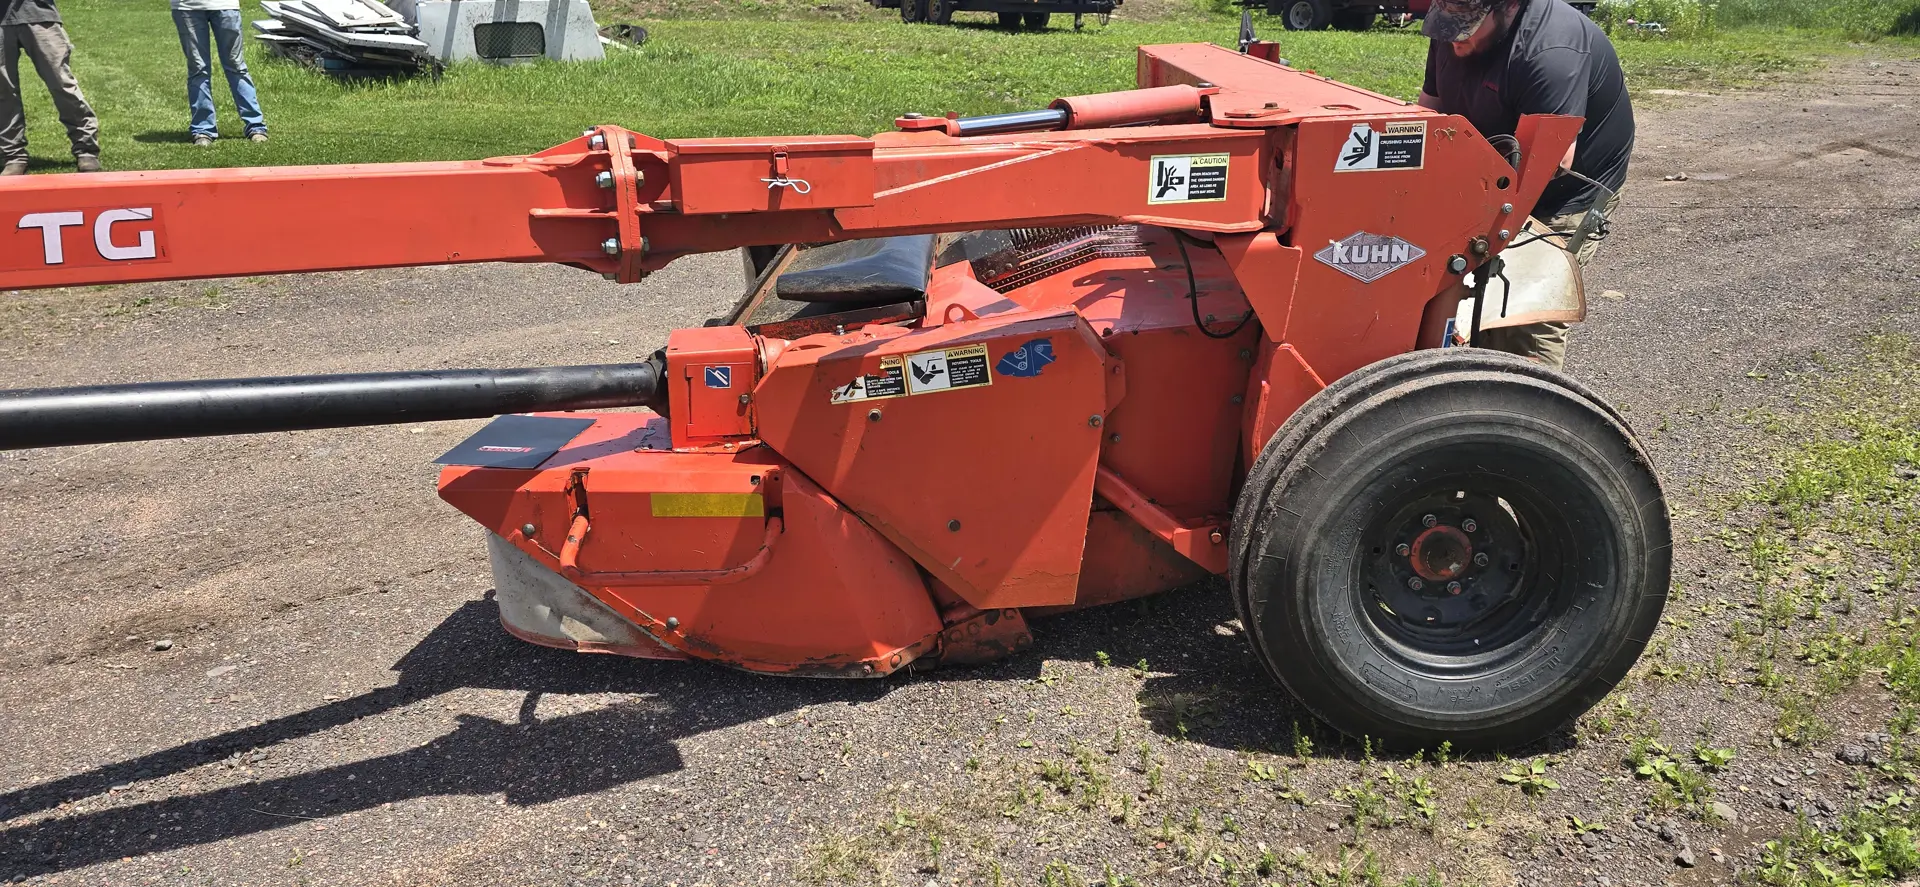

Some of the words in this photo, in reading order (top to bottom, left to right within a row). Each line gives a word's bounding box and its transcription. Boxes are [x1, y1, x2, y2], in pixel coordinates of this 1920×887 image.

[1388, 126, 1422, 134] WARNING
[1199, 157, 1227, 165] CAUTION
[1332, 244, 1410, 264] KUHN
[952, 347, 984, 357] WARNING
